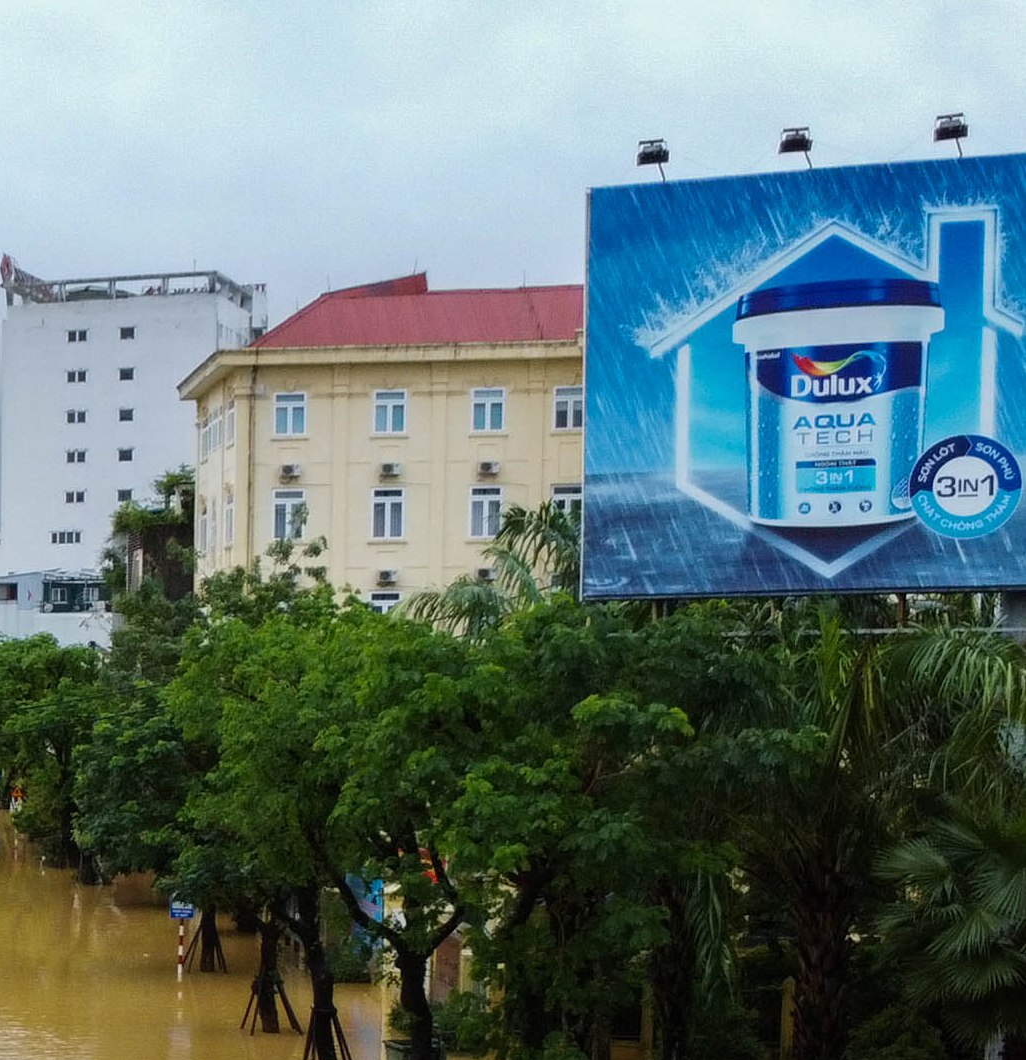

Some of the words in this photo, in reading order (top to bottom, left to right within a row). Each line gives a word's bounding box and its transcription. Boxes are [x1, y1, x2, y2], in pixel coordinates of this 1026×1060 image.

[790, 374, 873, 398] Dulux
[793, 412, 876, 430] AQUA
[796, 429, 873, 445] TECH
